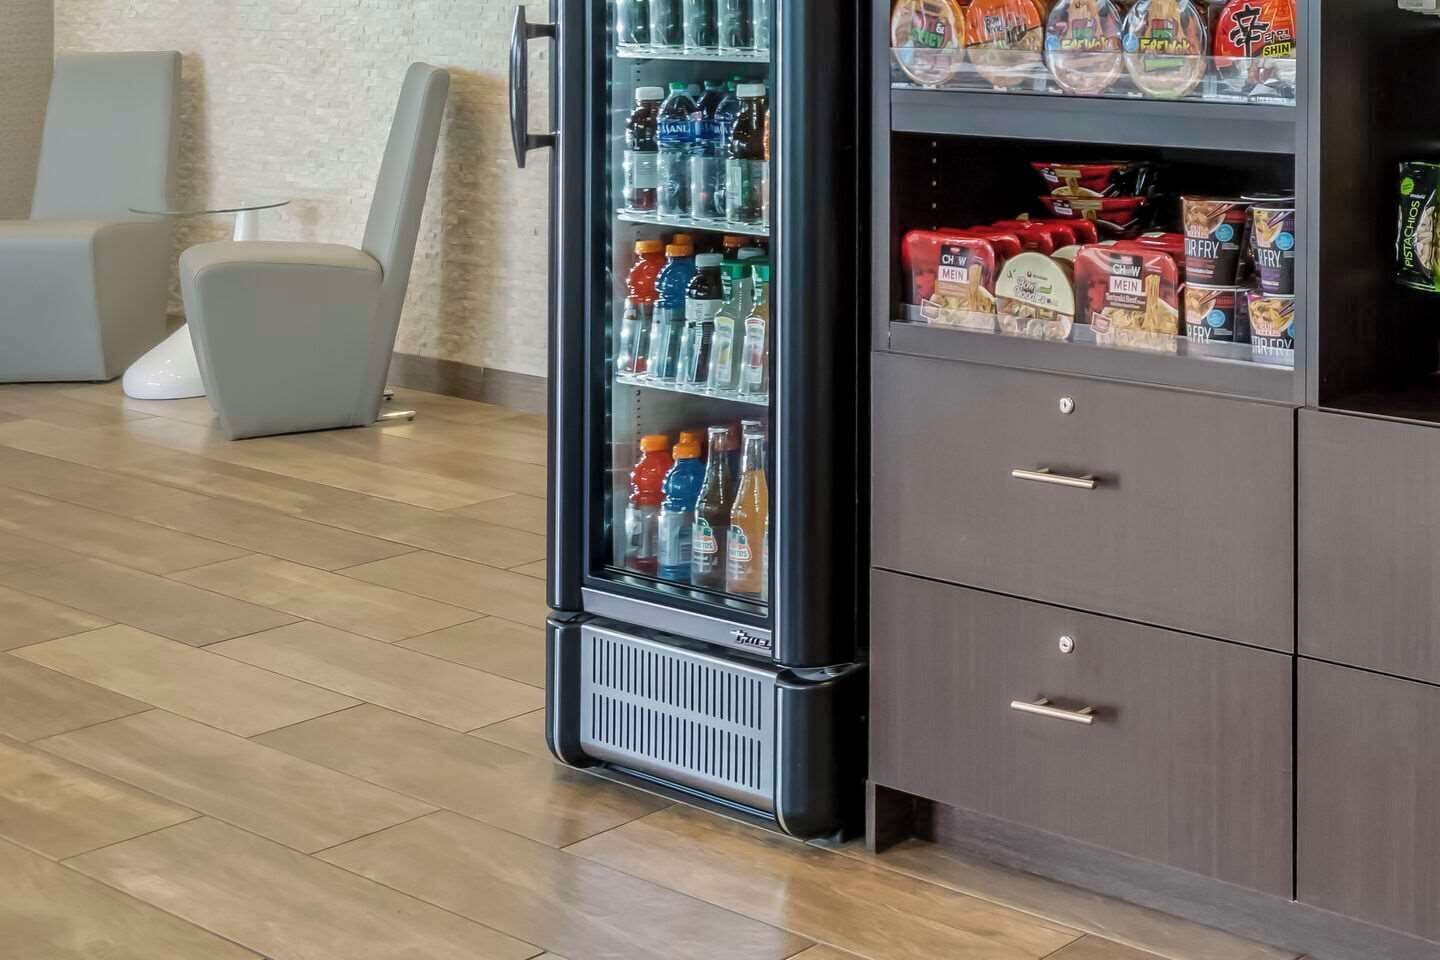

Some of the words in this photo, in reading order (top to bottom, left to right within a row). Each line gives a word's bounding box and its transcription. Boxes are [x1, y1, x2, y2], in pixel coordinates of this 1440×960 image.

[1264, 43, 1289, 55] SHIN
[1403, 200, 1421, 268] PISTACHIOS
[1198, 240, 1219, 259] FRY
[942, 268, 965, 282] MEIN
[1114, 279, 1138, 293] MEIN
